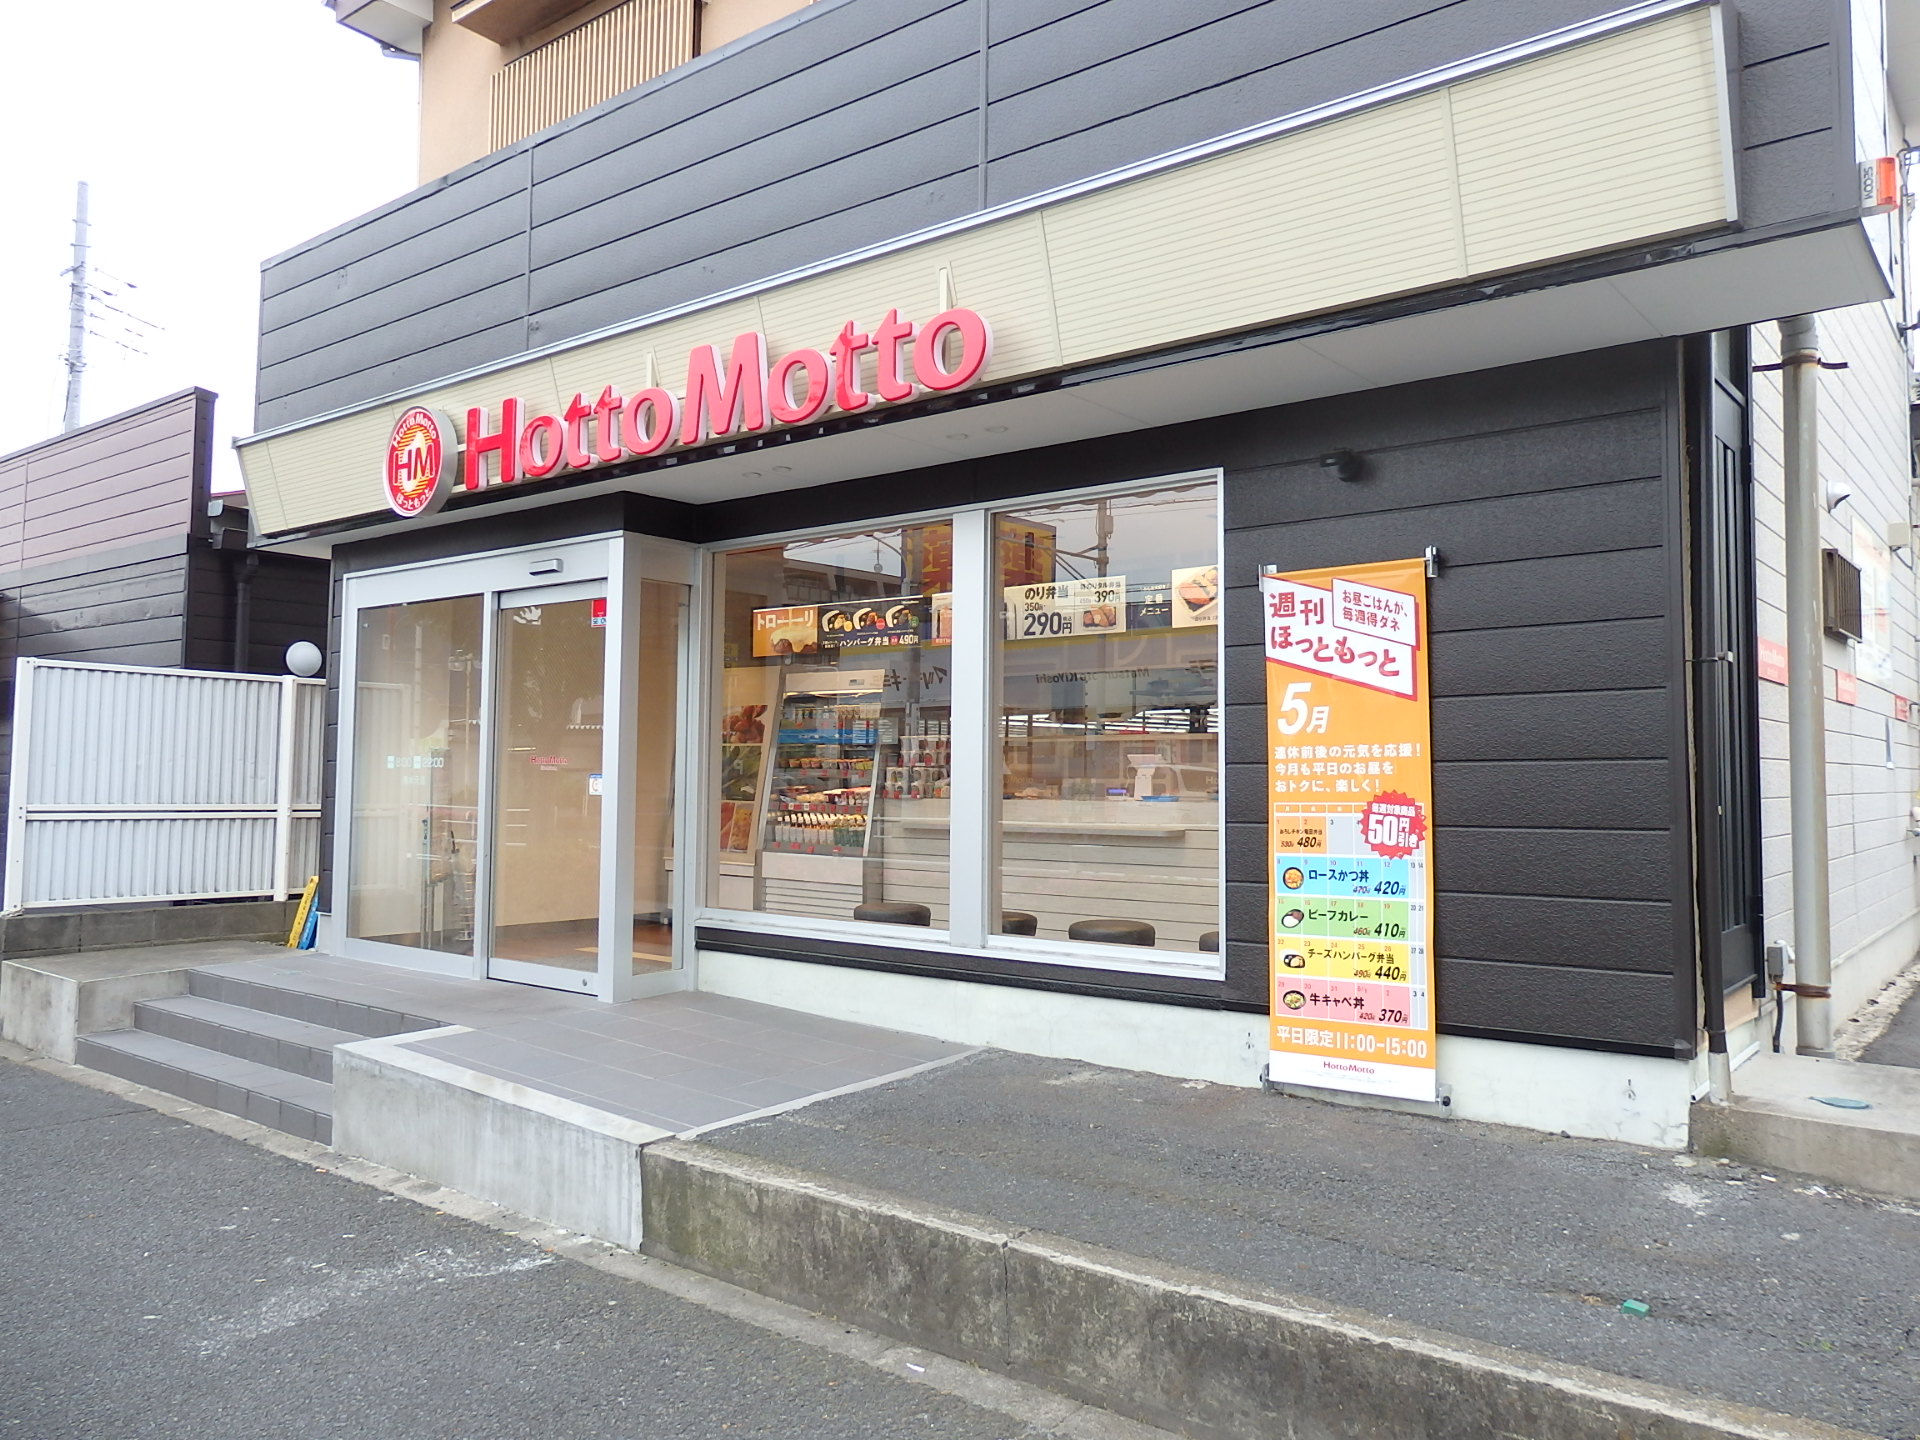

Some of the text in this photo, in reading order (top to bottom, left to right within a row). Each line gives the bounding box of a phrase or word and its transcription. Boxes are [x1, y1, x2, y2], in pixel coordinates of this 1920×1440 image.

[1863, 166, 1874, 200] SECOM
[464, 308, 993, 491] HottoMotto
[393, 443, 436, 486] HM
[396, 488, 432, 510] ほっともっと
[1024, 585, 1068, 600] のり弁当
[1140, 607, 1168, 616] メニュー
[1269, 592, 1324, 626] 週刊
[1342, 590, 1408, 617] お昼ごはんが、
[1024, 612, 1072, 636] 290円
[1343, 607, 1400, 632] 毎週得ダネ
[840, 636, 889, 647] ハンバーグ弁当
[899, 634, 918, 644] 490円
[1271, 625, 1400, 677] ほっともっと
[1278, 682, 1330, 735] 5月
[1274, 762, 1394, 776] 今月も平日のお昼を
[1308, 869, 1370, 882] ロースかつ丼
[1308, 909, 1368, 922] ビーフカレー
[1308, 949, 1395, 964] チーズハンバーグ弁当
[1310, 993, 1365, 1009] 牛キャベ丼
[1323, 1061, 1375, 1074] HottoMotto
